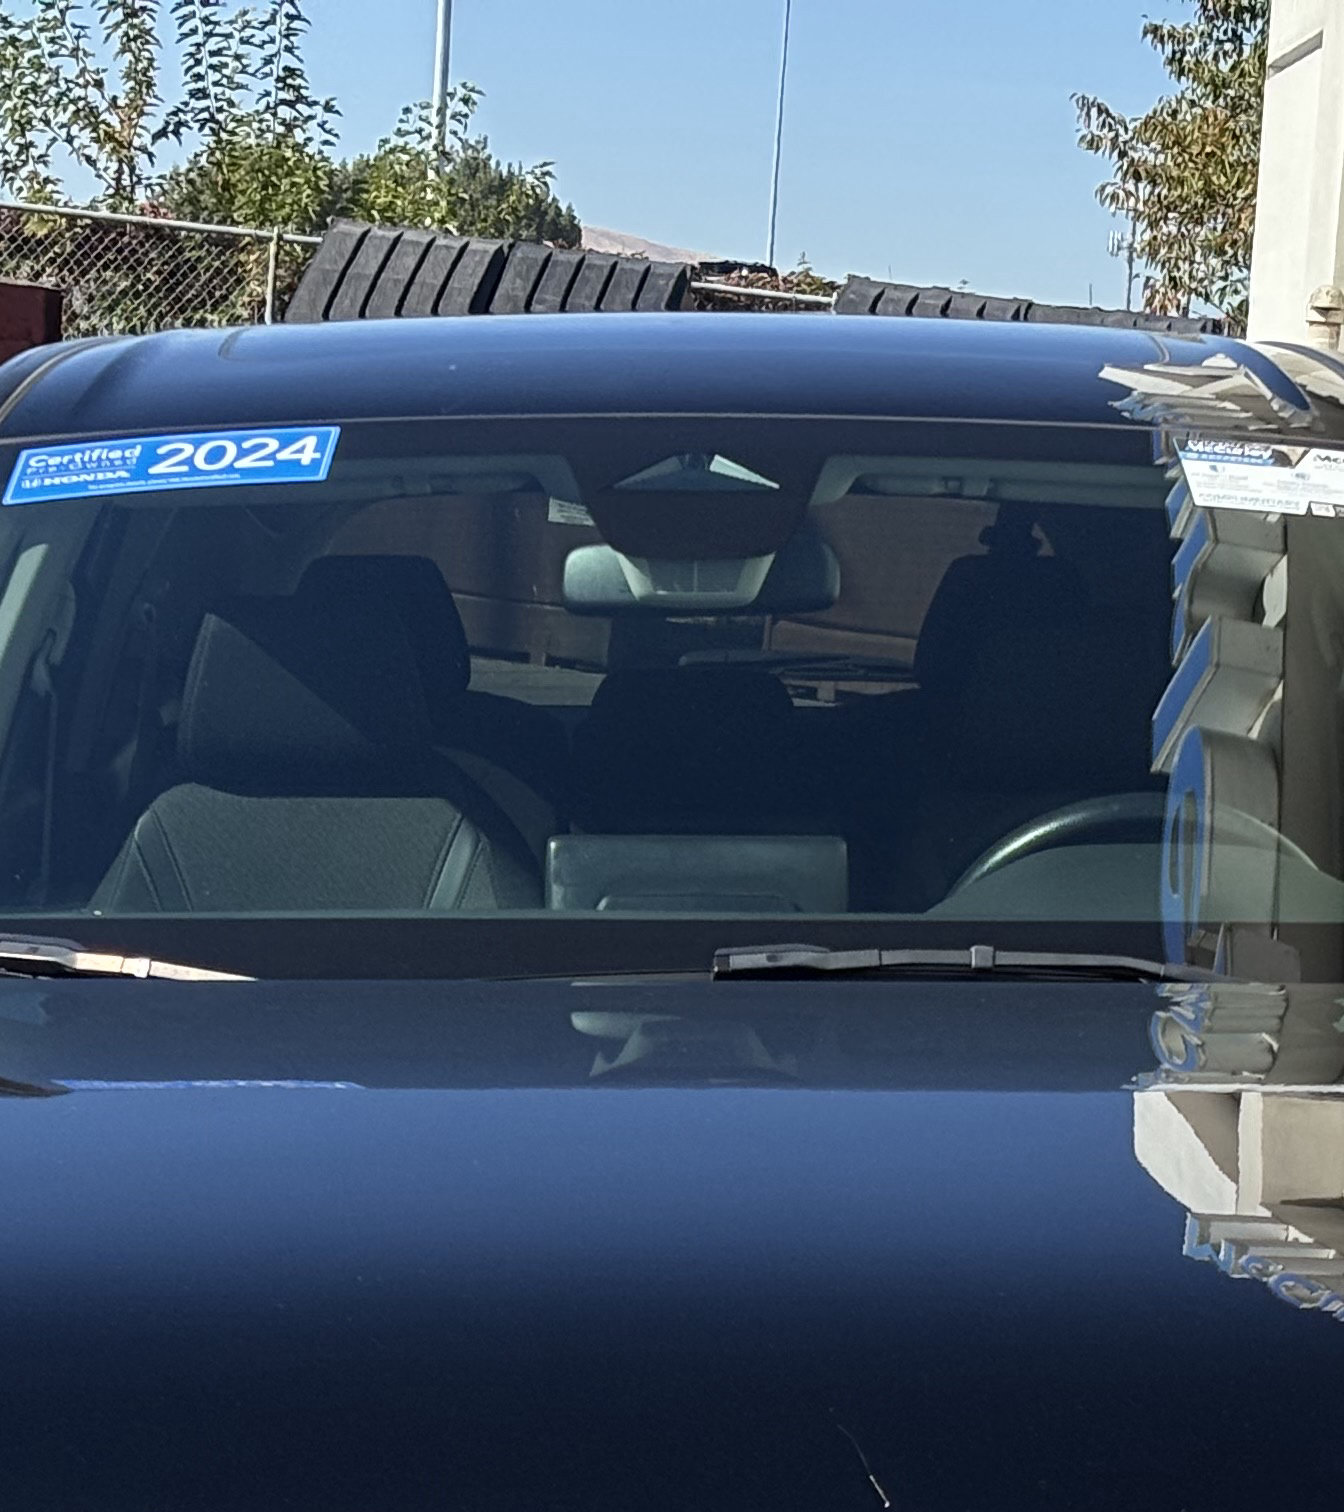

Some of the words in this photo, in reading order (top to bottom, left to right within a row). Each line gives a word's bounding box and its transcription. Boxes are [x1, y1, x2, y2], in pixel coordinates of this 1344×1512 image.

[28, 444, 142, 467] Certified
[148, 435, 321, 474] 2024
[43, 470, 131, 486] HONDA
